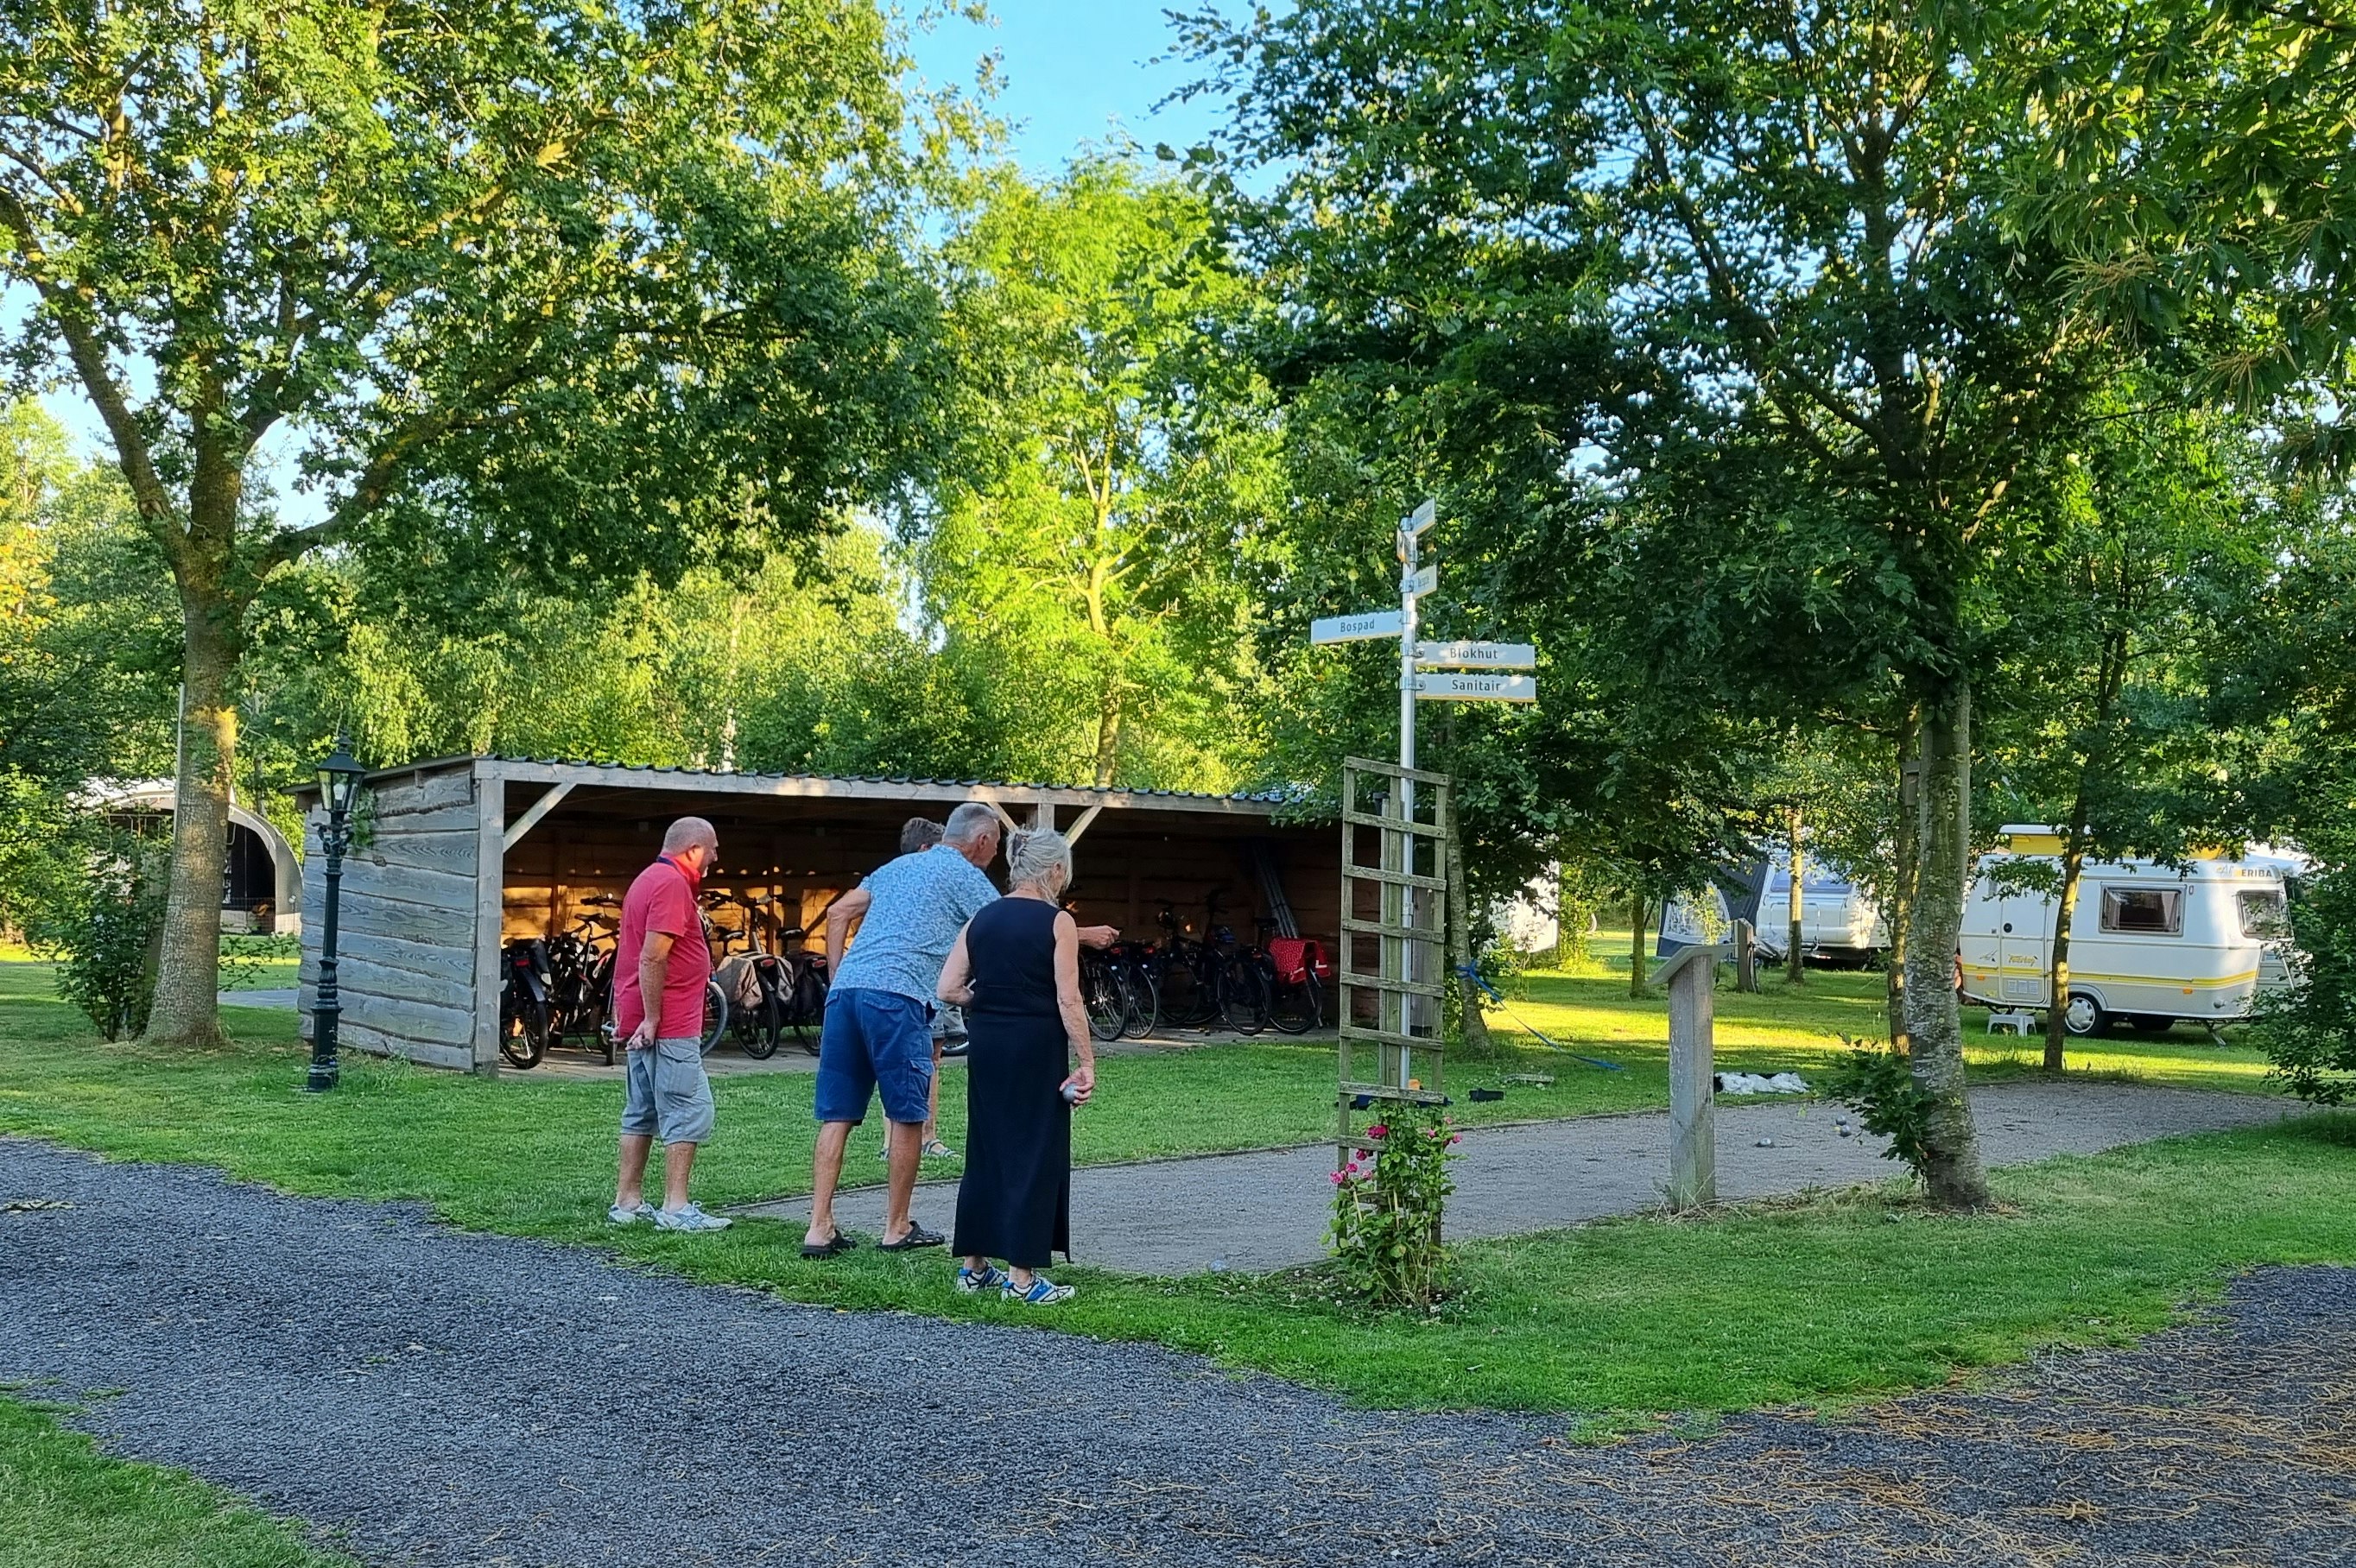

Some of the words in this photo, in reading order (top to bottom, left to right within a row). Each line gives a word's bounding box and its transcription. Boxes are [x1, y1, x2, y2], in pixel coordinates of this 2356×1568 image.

[1340, 618, 1375, 633] Bospad
[1450, 648, 1498, 660] Blokhut
[1452, 679, 1501, 692] Sanitair
[2241, 869, 2272, 877] ERIBA
